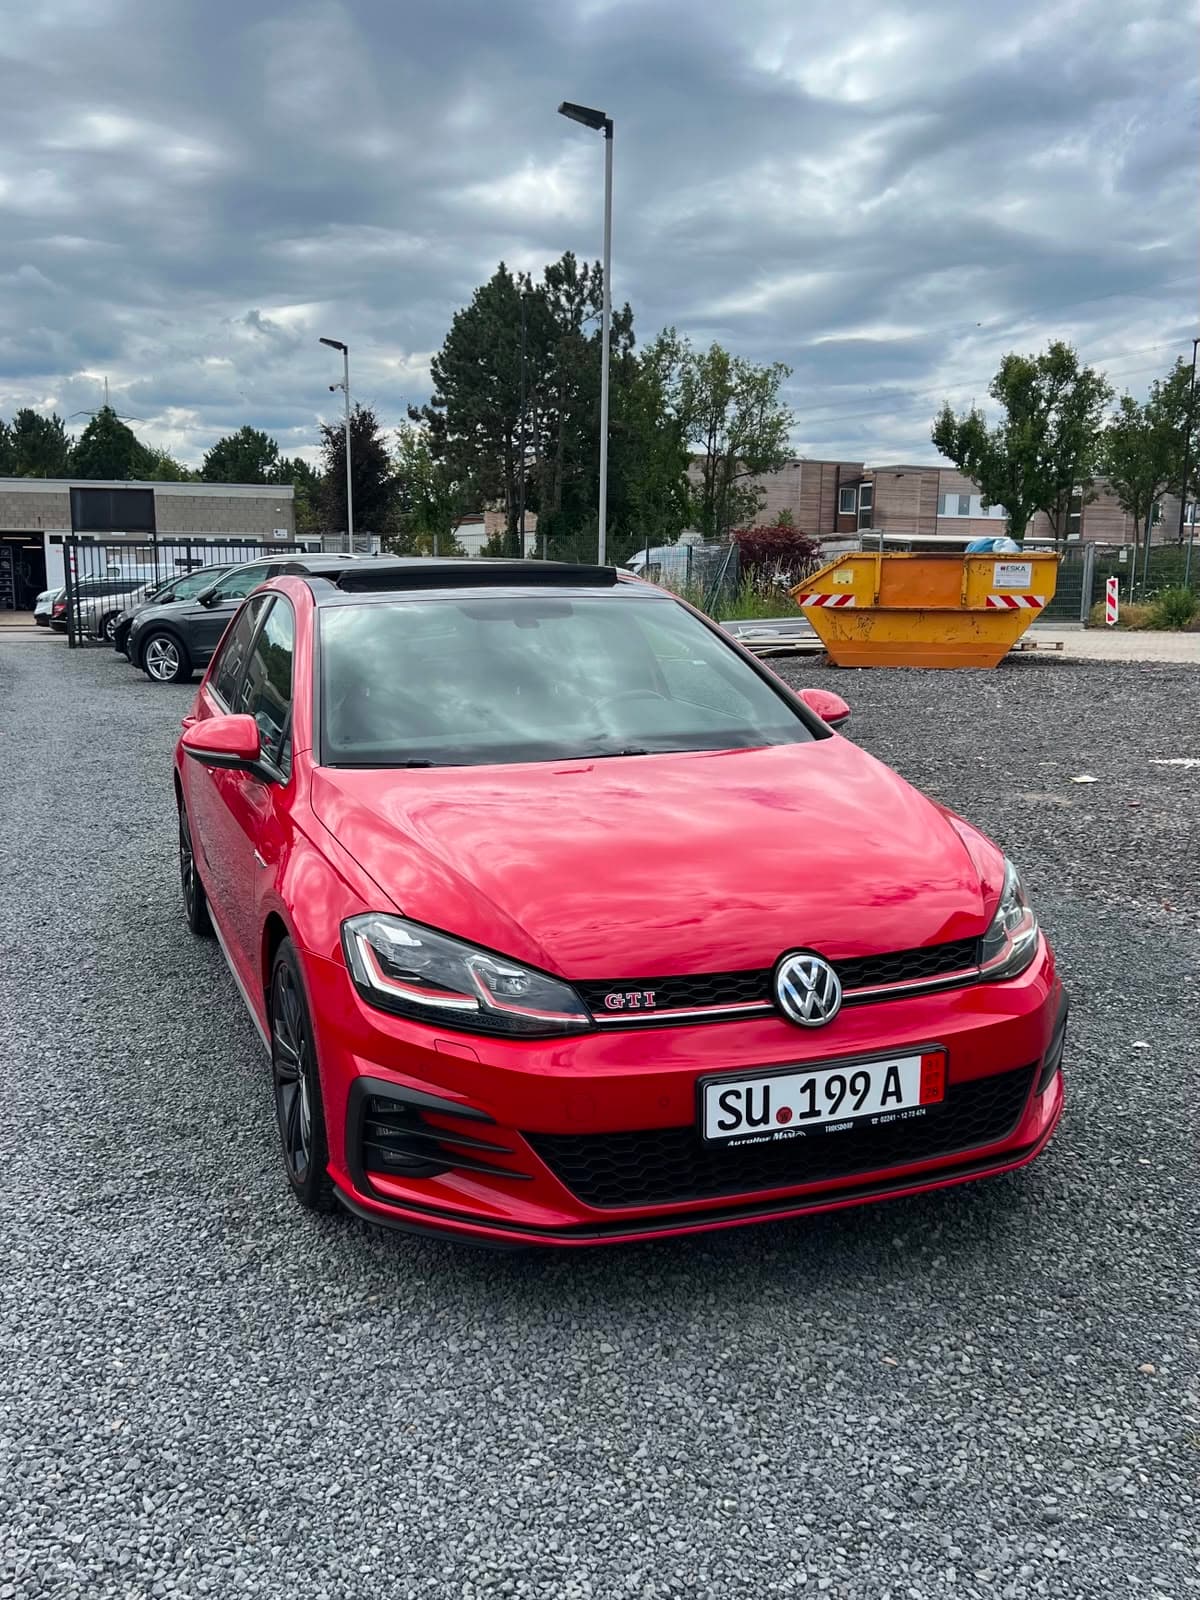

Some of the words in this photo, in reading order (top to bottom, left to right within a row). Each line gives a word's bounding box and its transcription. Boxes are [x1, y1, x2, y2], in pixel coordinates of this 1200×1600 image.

[604, 991, 657, 1010] GTI
[780, 955, 839, 1024] VW
[717, 1084, 771, 1131] SU
[799, 1071, 871, 1120] 199
[880, 1065, 903, 1106] A
